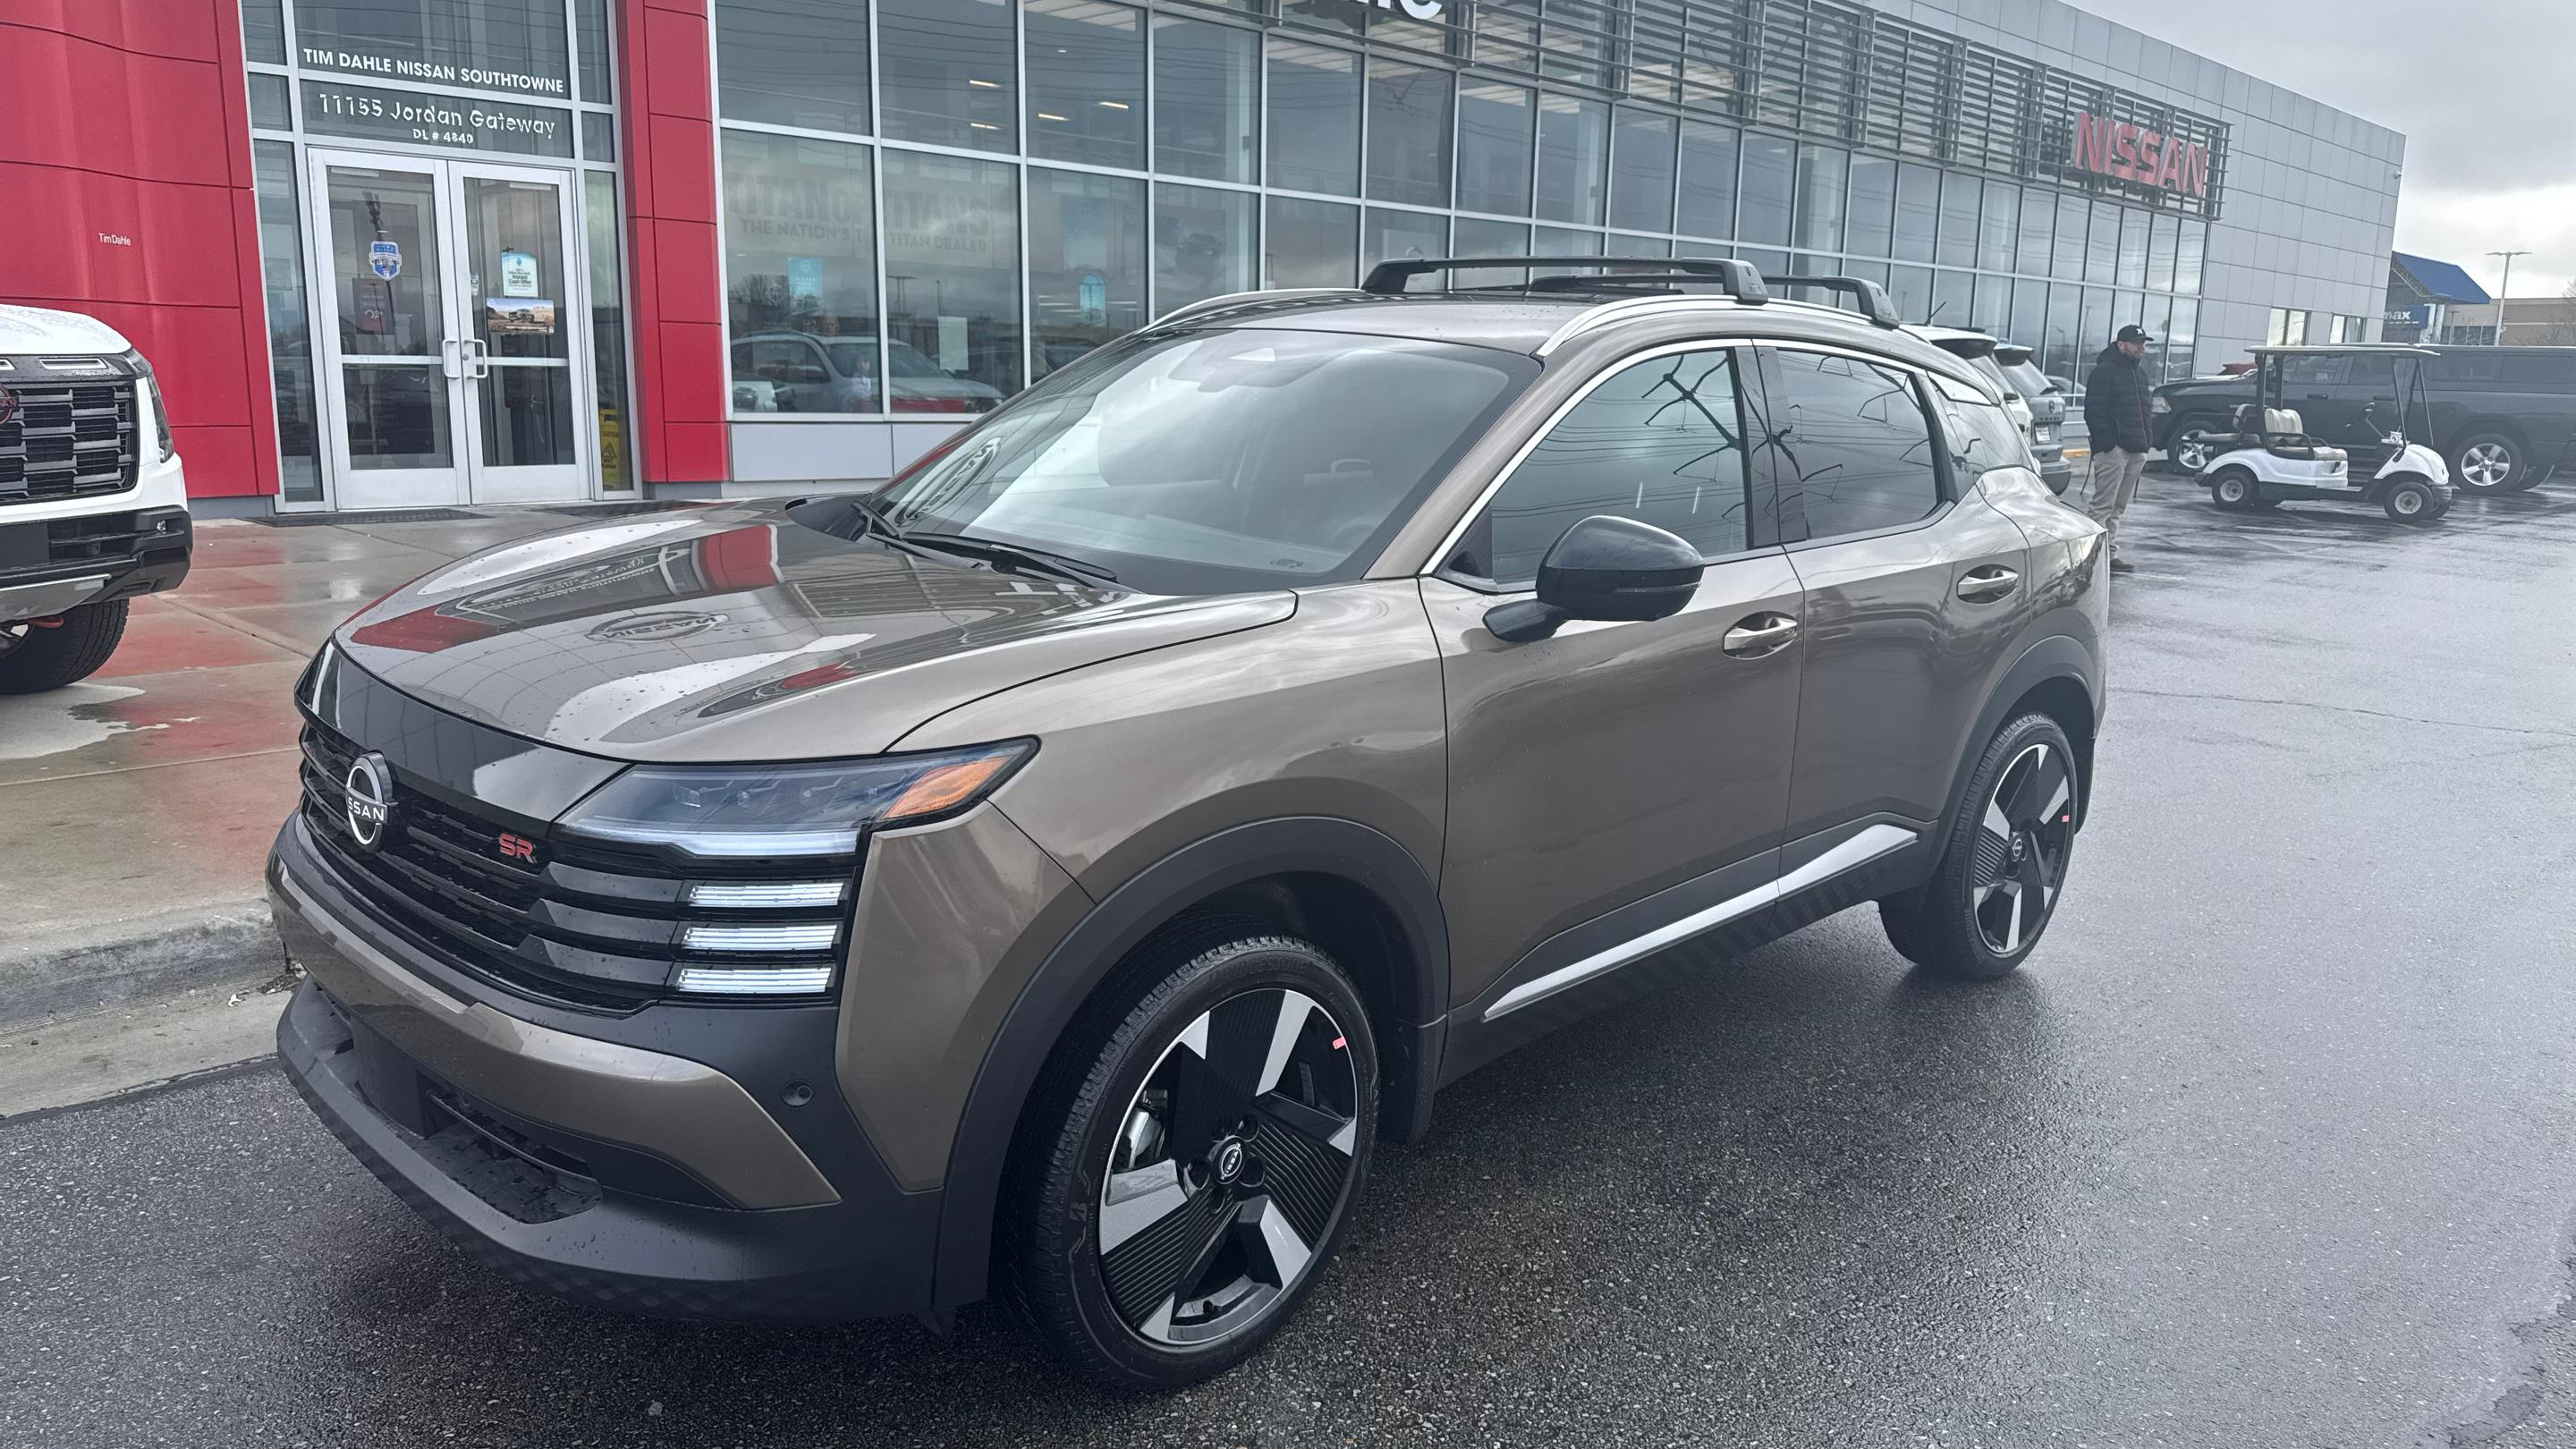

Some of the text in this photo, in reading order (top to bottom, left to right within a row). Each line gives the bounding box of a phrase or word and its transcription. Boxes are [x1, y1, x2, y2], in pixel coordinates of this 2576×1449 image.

[303, 48, 564, 93] TIM DAHLE NISSAN SOUTHTOWNE
[319, 93, 555, 140] 11155 Jordan Gateway
[412, 128, 474, 144] DL # 4840
[2072, 111, 2208, 197] NISSAN
[97, 232, 131, 246] Tim Dahle
[741, 217, 773, 236] THE
[777, 222, 851, 242] NATION'S
[888, 232, 930, 249] TITAN
[934, 235, 987, 252] DEALER
[2384, 310, 2411, 320] max
[348, 796, 385, 822] SSAN
[499, 833, 535, 864] SR
